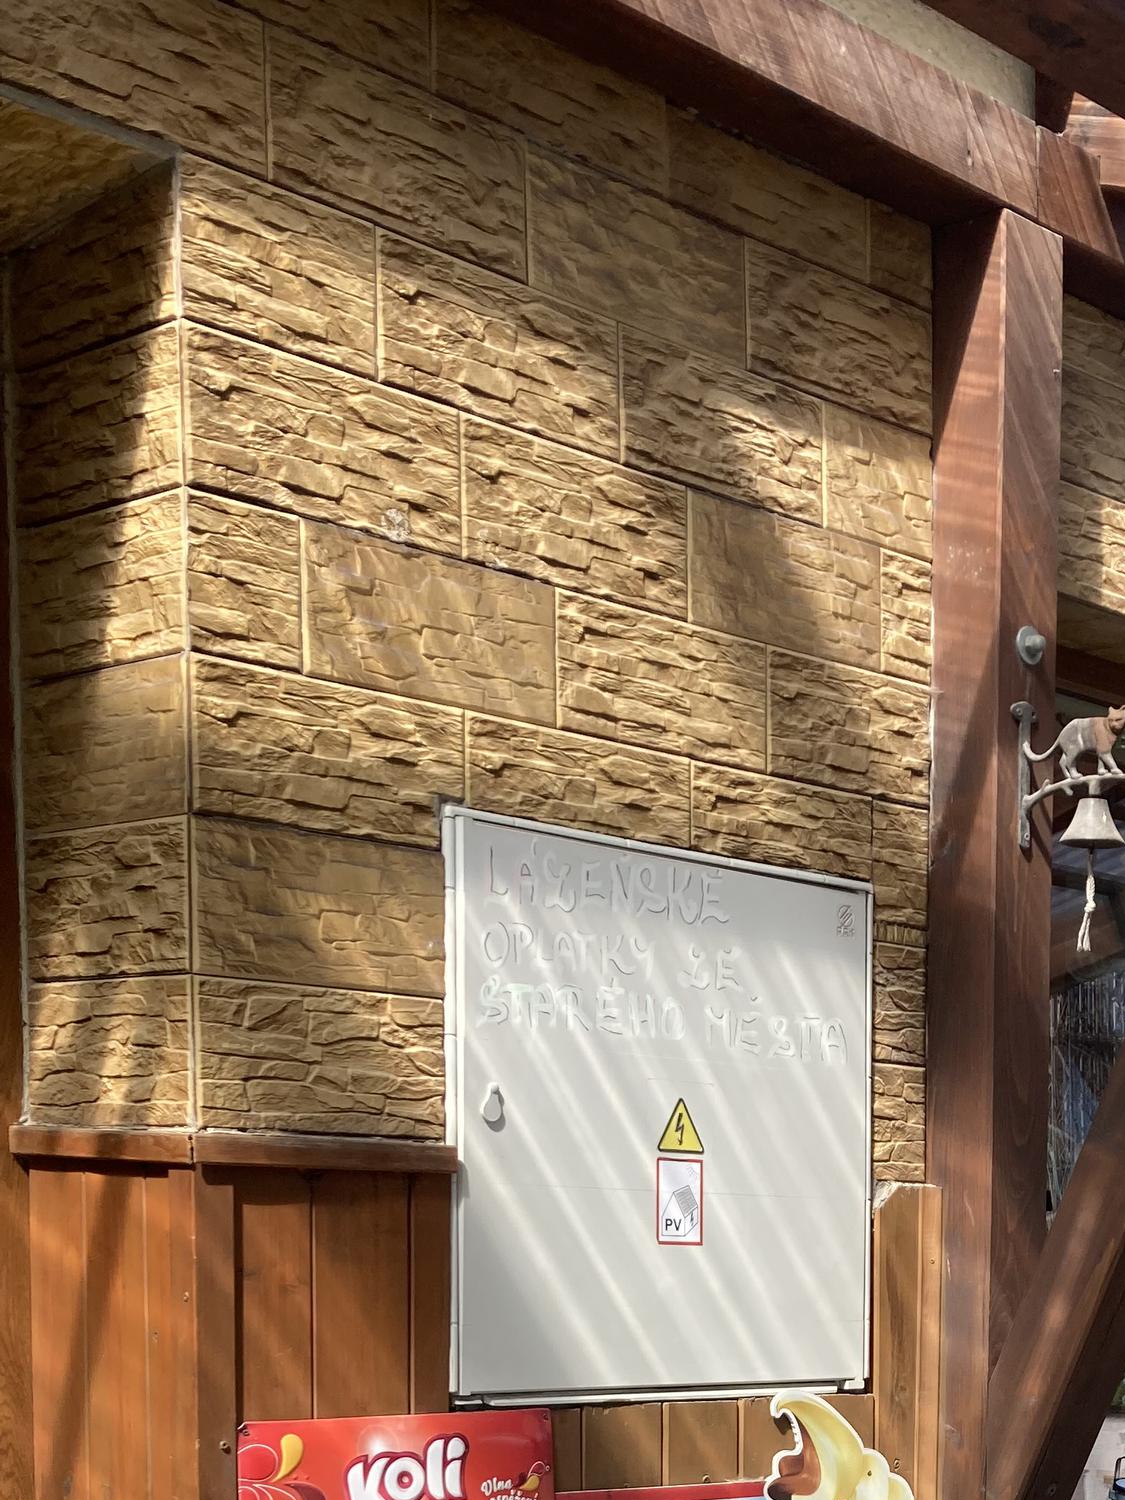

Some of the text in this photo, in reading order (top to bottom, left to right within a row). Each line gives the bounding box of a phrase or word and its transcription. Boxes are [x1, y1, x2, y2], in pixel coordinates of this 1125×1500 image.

[484, 920, 655, 981] OPLATKY
[477, 974, 849, 1064] STARÉHO MĚSTA
[664, 1218, 682, 1232] PV
[481, 1477, 512, 1497] Vlna
